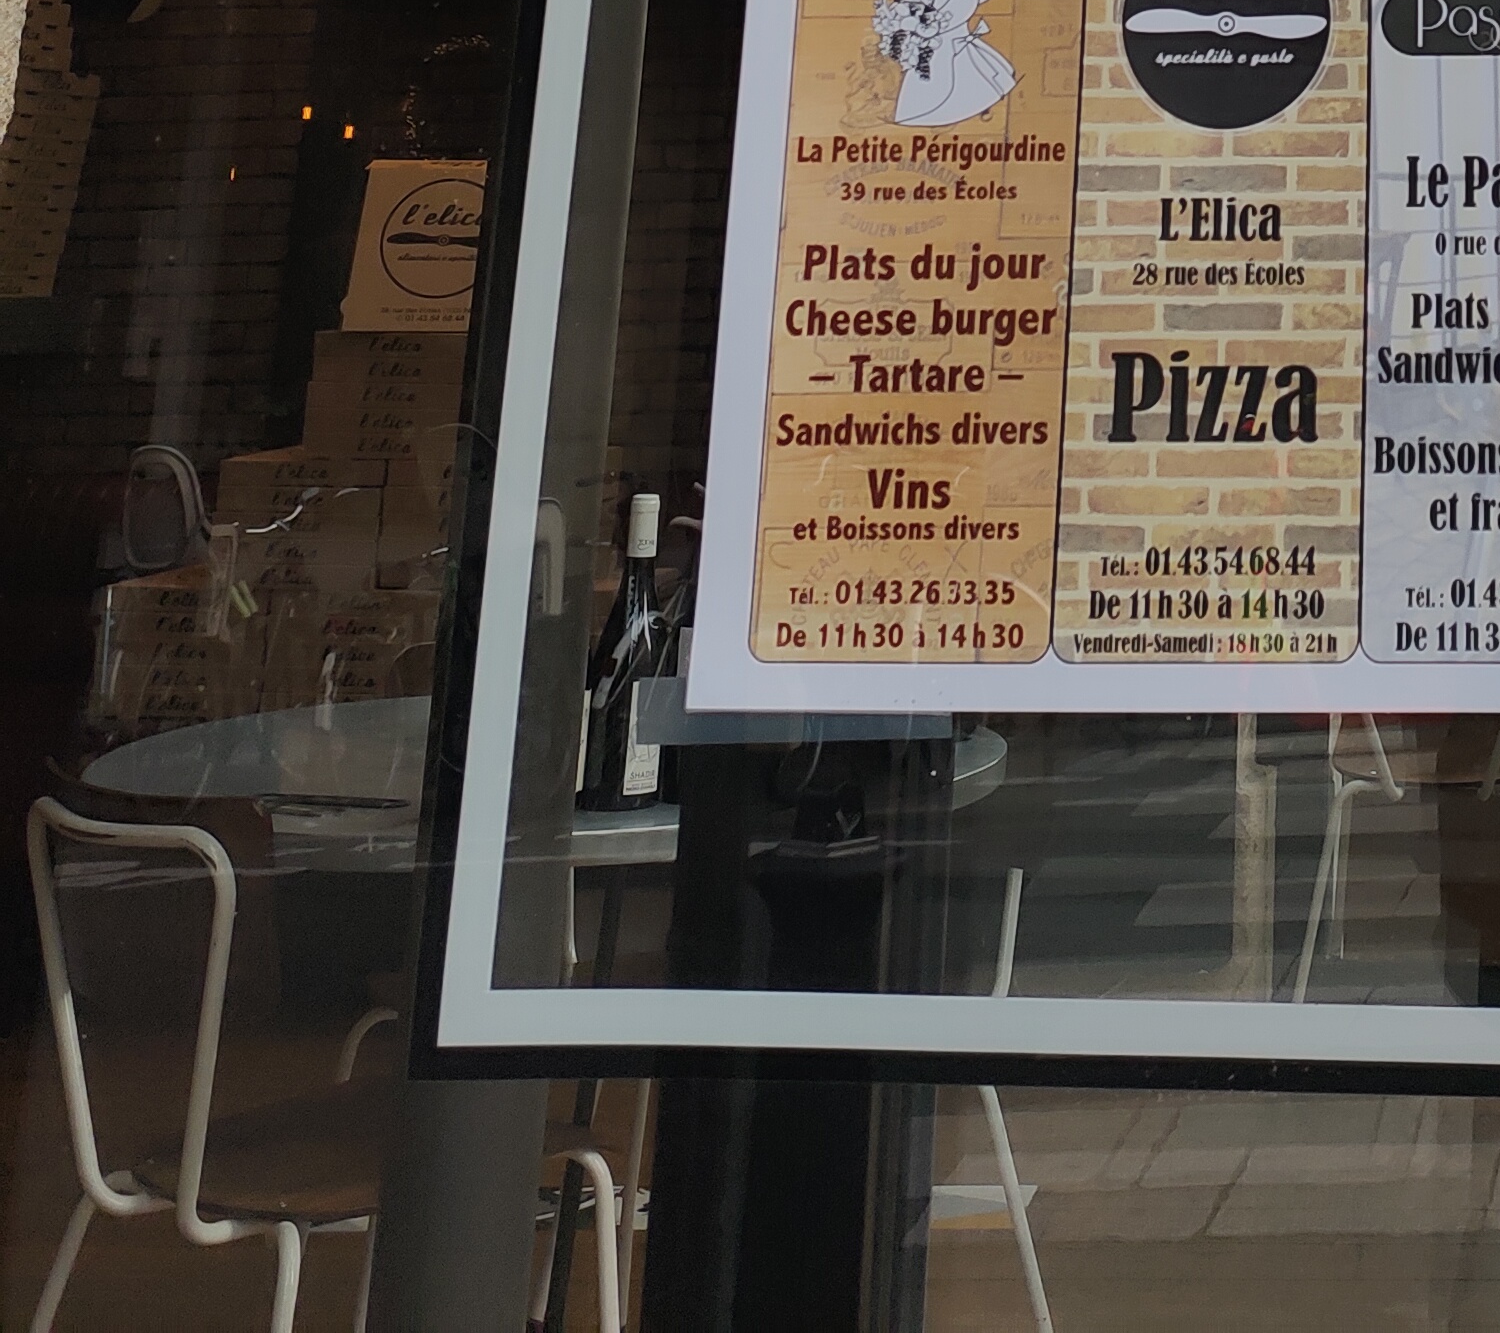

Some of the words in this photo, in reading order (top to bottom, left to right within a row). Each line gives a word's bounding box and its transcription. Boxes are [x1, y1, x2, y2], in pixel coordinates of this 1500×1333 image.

[1237, 52, 1247, 64] e
[1250, 47, 1294, 67] gusto
[796, 136, 822, 163] La
[831, 136, 902, 163] Petite
[911, 134, 1065, 170] Périgourdine
[840, 182, 866, 201] 39
[874, 185, 905, 201] rue
[913, 181, 947, 201] des
[955, 176, 1018, 200] Écoles
[1406, 156, 1449, 208] Le
[1159, 197, 1282, 242] L'Elica
[1454, 236, 1487, 256] rue
[803, 244, 895, 281] Plats
[910, 243, 955, 280] du
[966, 242, 1046, 291] jour
[1132, 263, 1158, 286] 28
[1165, 267, 1199, 286] rue
[1205, 263, 1238, 286] des
[1244, 258, 1305, 286] Écoles
[786, 299, 916, 337] Cheese
[931, 298, 1057, 346] burger
[1411, 292, 1489, 330] Plats
[849, 355, 985, 393] Tartare
[1107, 350, 1319, 443] Pizza
[776, 413, 940, 446] Sandwichs
[952, 412, 1049, 445] divers
[867, 468, 951, 510] Vins
[793, 518, 818, 540] et
[827, 515, 935, 541] Boissons
[944, 515, 1020, 541] divers
[1429, 492, 1459, 531] et
[1145, 545, 1316, 577] 01.43.54.68.44
[835, 580, 1016, 606] 01.43.26.33.35
[1089, 589, 1121, 620] De
[1218, 587, 1232, 620] à
[776, 623, 806, 649] De
[914, 624, 925, 649] à
[1289, 632, 1299, 653] à
[1395, 622, 1427, 651] De
